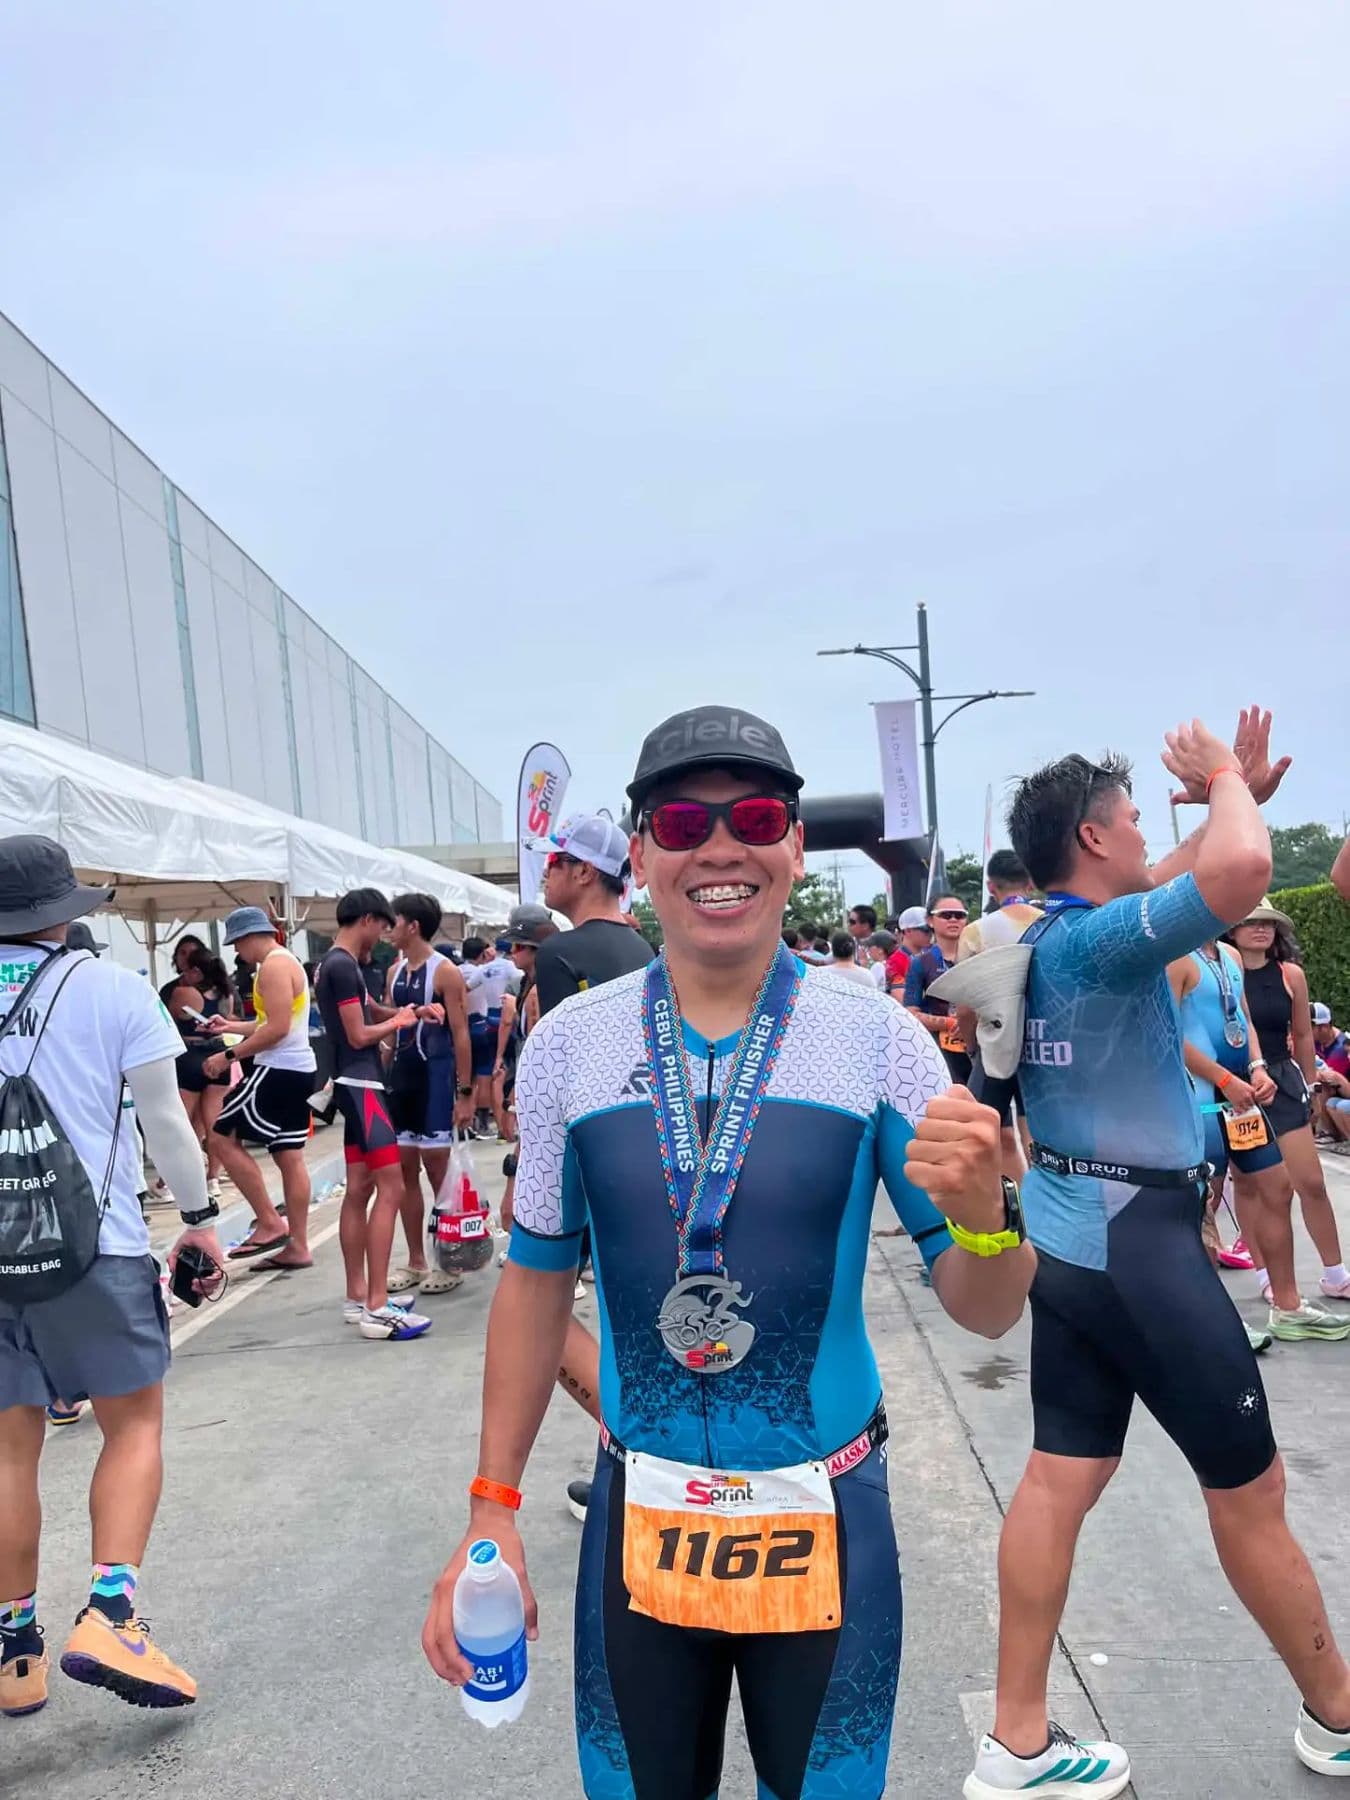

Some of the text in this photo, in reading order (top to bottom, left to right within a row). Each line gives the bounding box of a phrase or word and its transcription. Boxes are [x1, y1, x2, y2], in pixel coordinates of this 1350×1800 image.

[656, 715, 773, 757] ciele
[891, 718, 901, 761] HOTEL
[528, 769, 557, 838] Sprint
[655, 999, 695, 1173] CEBU, PHILIPPINES
[711, 1013, 776, 1174] SPRINT FINISHER
[0, 1258, 62, 1274] USABLE BAG
[687, 1349, 733, 1369] Sprint
[831, 1439, 868, 1473] ALASKA
[685, 1480, 754, 1505] Sprint
[656, 1527, 815, 1580] 1162
